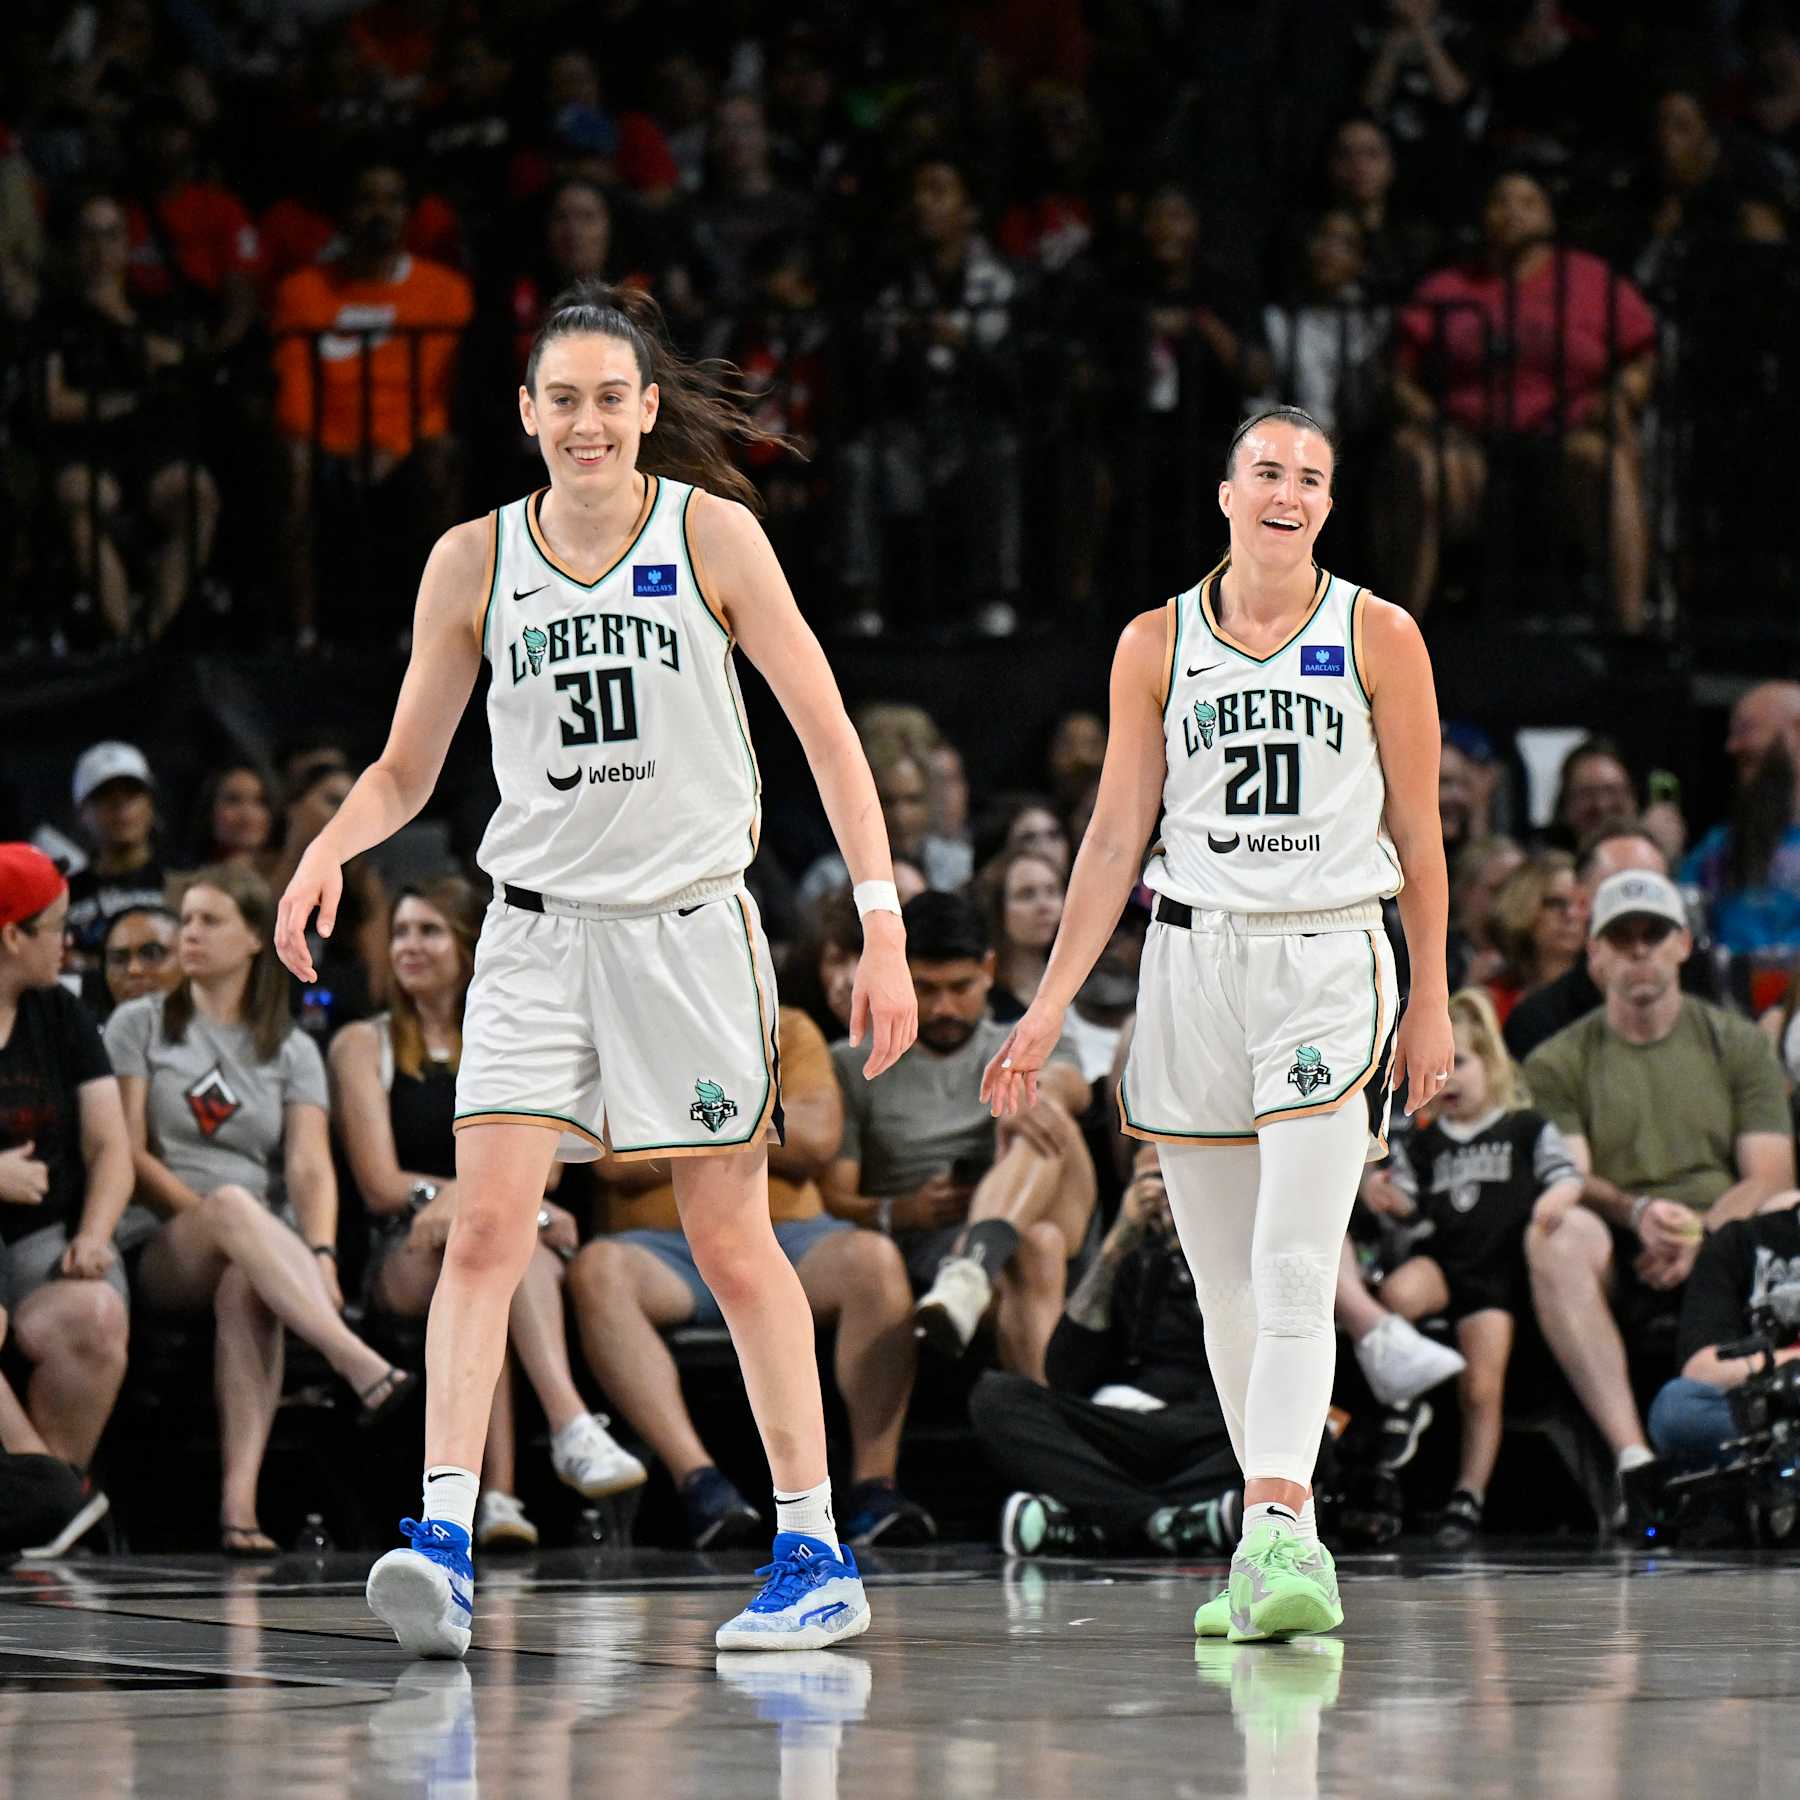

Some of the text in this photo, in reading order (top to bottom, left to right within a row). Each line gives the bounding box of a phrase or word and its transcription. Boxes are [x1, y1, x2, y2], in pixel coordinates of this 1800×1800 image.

[1305, 664, 1341, 672] BARCLAYS
[554, 667, 638, 747] 30
[589, 760, 655, 784] Webull
[1224, 743, 1300, 816] 20
[1247, 834, 1320, 852] Webull
